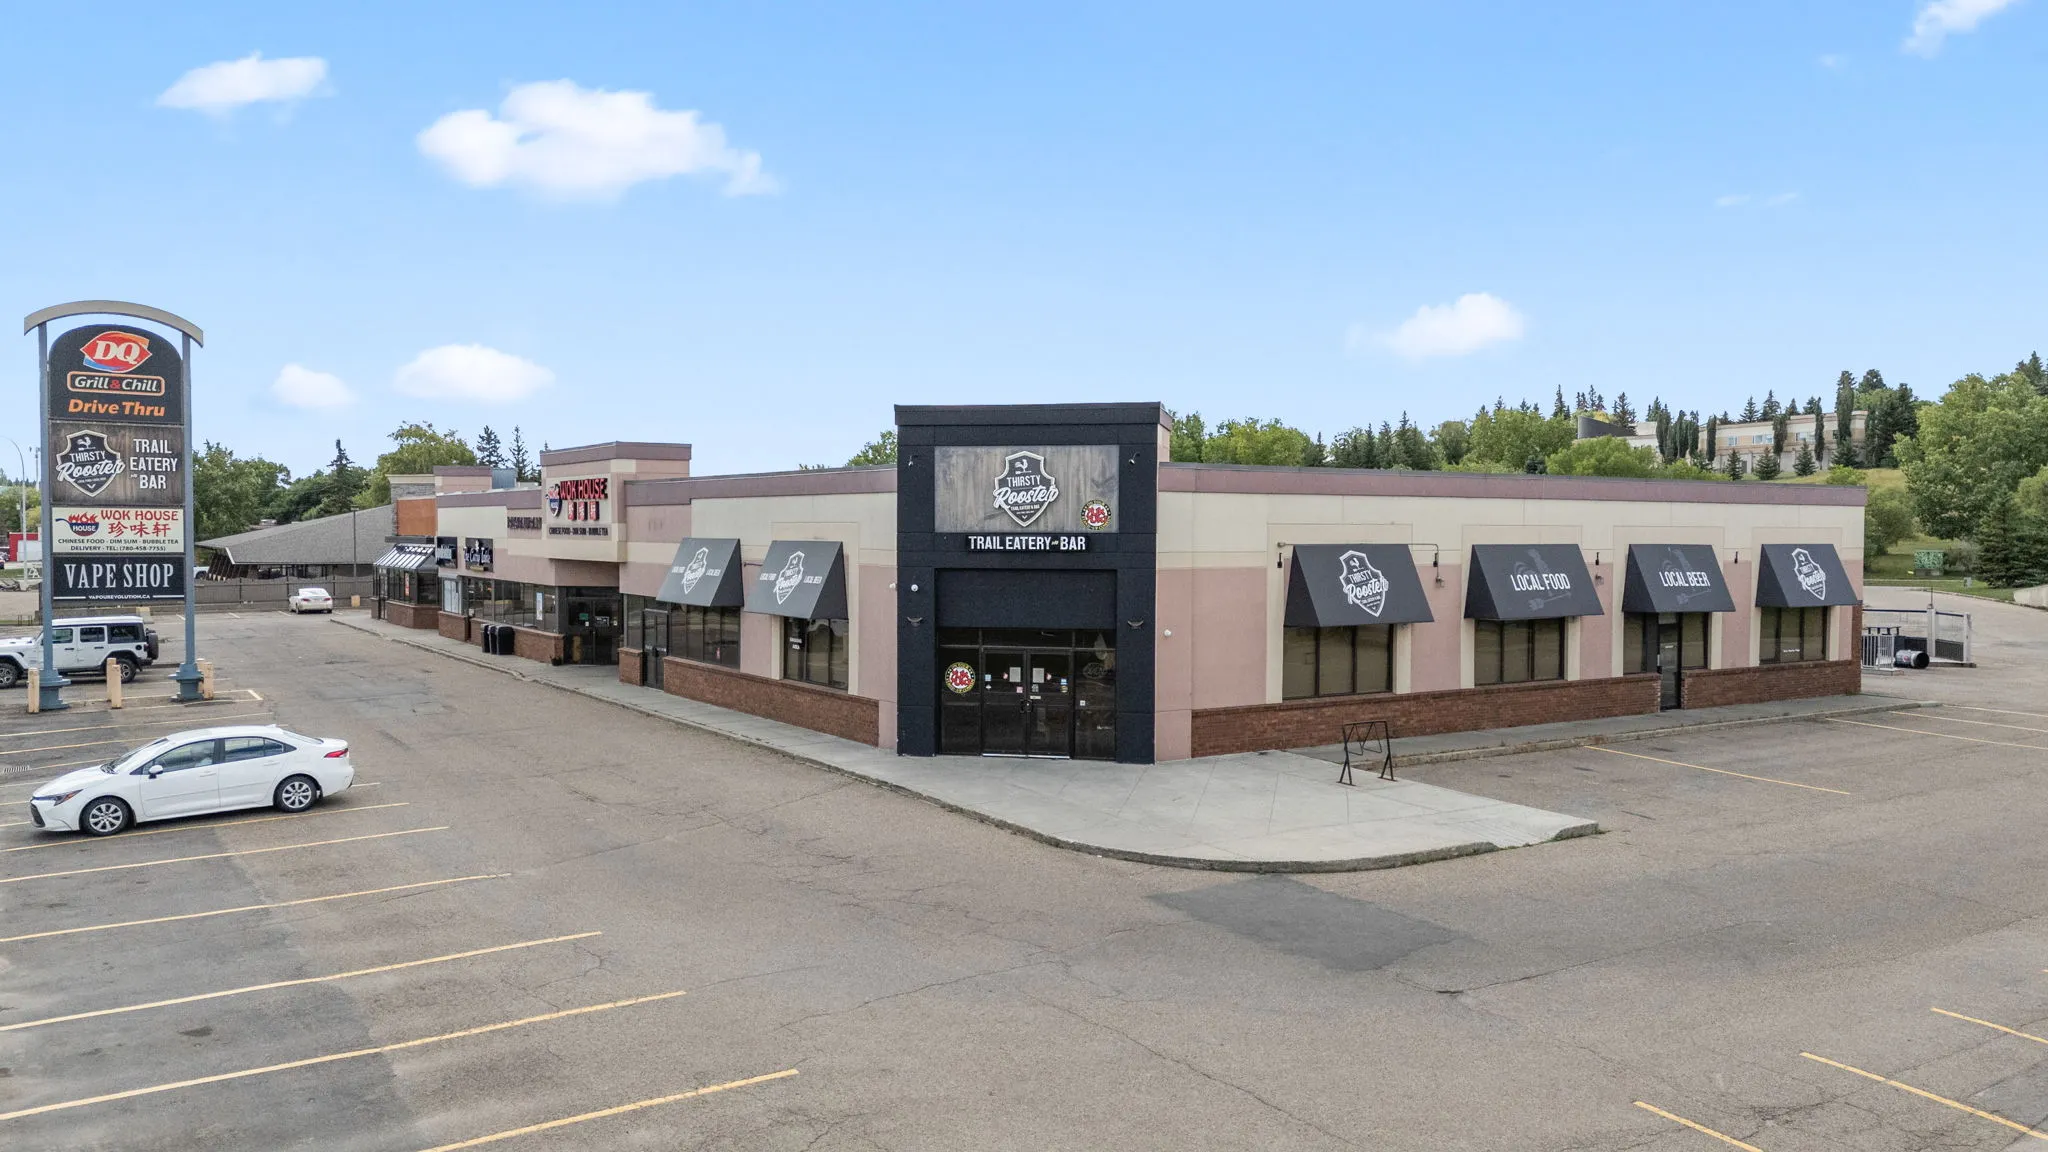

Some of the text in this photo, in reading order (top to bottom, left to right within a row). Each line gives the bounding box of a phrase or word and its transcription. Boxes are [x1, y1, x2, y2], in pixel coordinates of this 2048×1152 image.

[93, 340, 141, 364] DQ
[75, 376, 158, 392] Grill & Chill
[68, 398, 165, 417] Drive Thru
[133, 438, 172, 454] TRAIL
[69, 450, 106, 462] THIRSTY
[56, 459, 126, 481] Rooster
[130, 457, 178, 472] EATERY
[139, 475, 167, 489] BAR
[560, 480, 578, 500] WOK
[580, 478, 607, 500] HOUSE
[1007, 475, 1041, 487] THIRSTY
[993, 485, 1059, 508] Rooster
[100, 510, 179, 521] WOK HOUSE
[107, 521, 172, 538] 珍味轩
[968, 536, 1003, 549] TRAIL
[1006, 536, 1051, 550] EATERY
[1060, 536, 1086, 550] BAR
[64, 563, 174, 589] VAPE SHOP
[1348, 570, 1373, 583] THIRSTY
[1510, 573, 1571, 591] LOCAL FOOD
[1659, 571, 1711, 587] LOCAL BEER
[1343, 578, 1389, 604] Rooster
